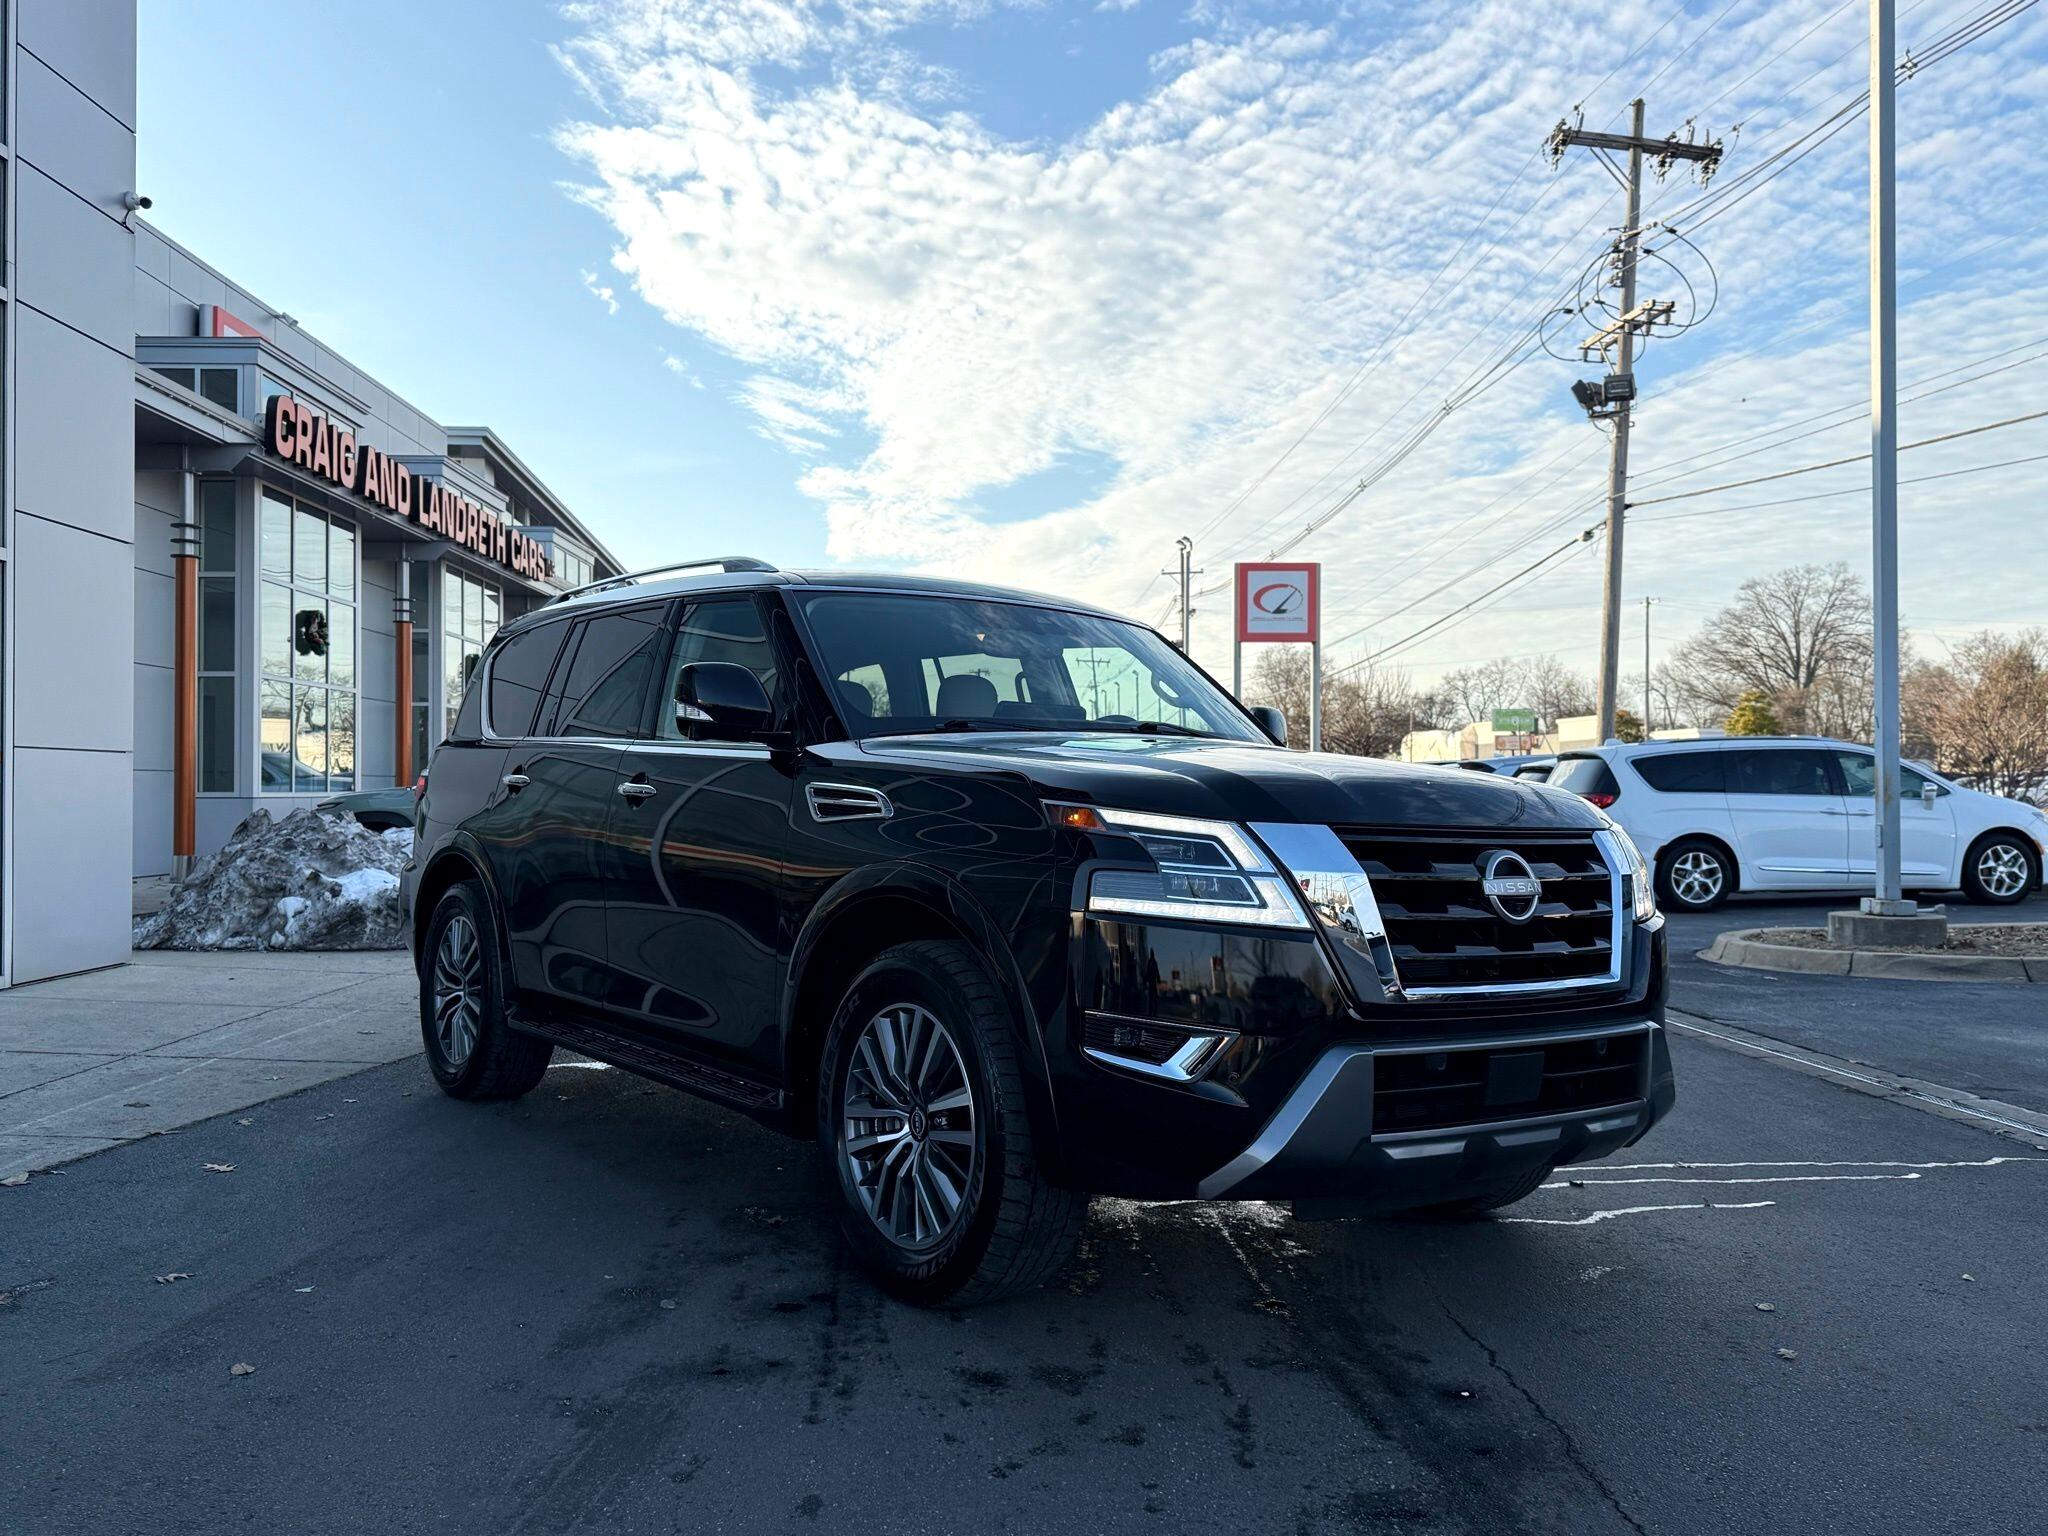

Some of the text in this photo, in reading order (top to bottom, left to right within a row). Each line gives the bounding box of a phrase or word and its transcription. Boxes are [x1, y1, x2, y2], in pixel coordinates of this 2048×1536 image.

[274, 394, 545, 582] CRAIG AND LANDRETH CARS
[1485, 882, 1541, 893] NISSAN
